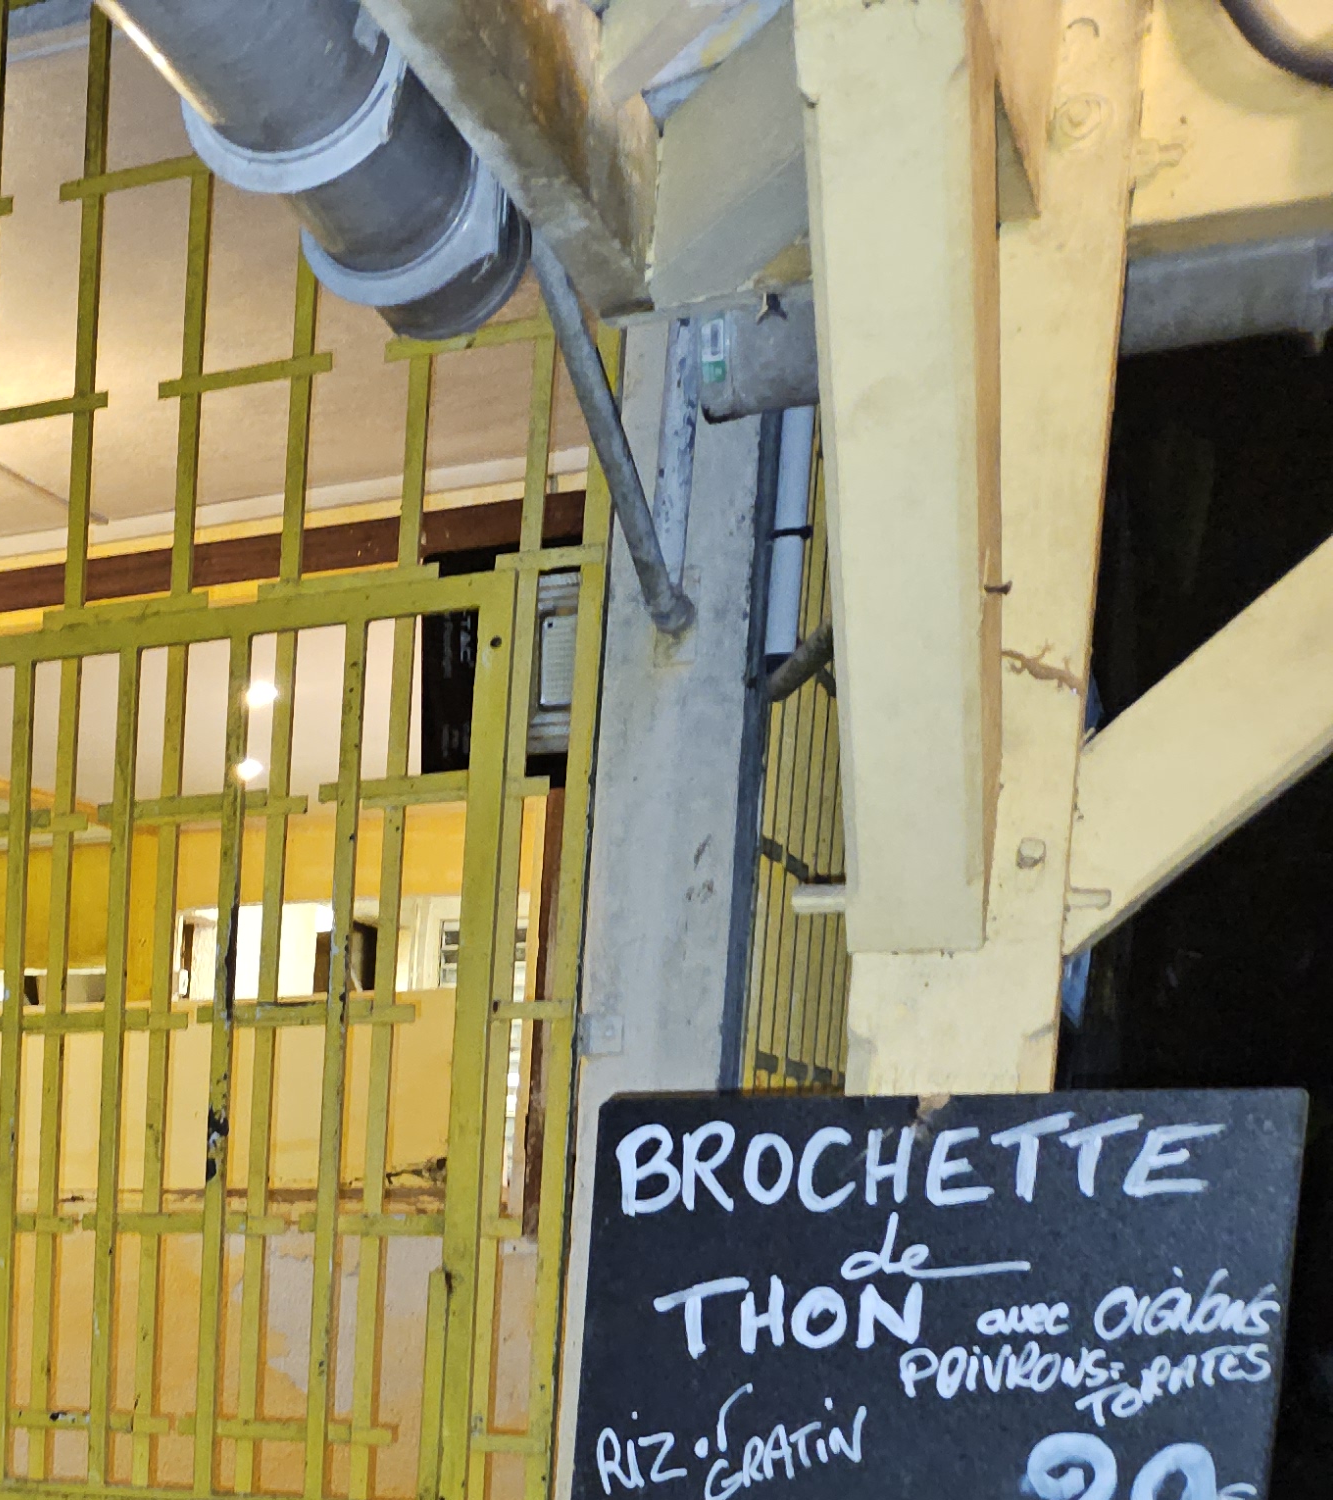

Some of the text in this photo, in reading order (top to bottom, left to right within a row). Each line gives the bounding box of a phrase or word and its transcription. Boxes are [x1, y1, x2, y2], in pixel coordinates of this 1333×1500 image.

[616, 1111, 1225, 1216] BROCHETTE
[841, 1212, 1031, 1282] de
[654, 1275, 923, 1359] THON
